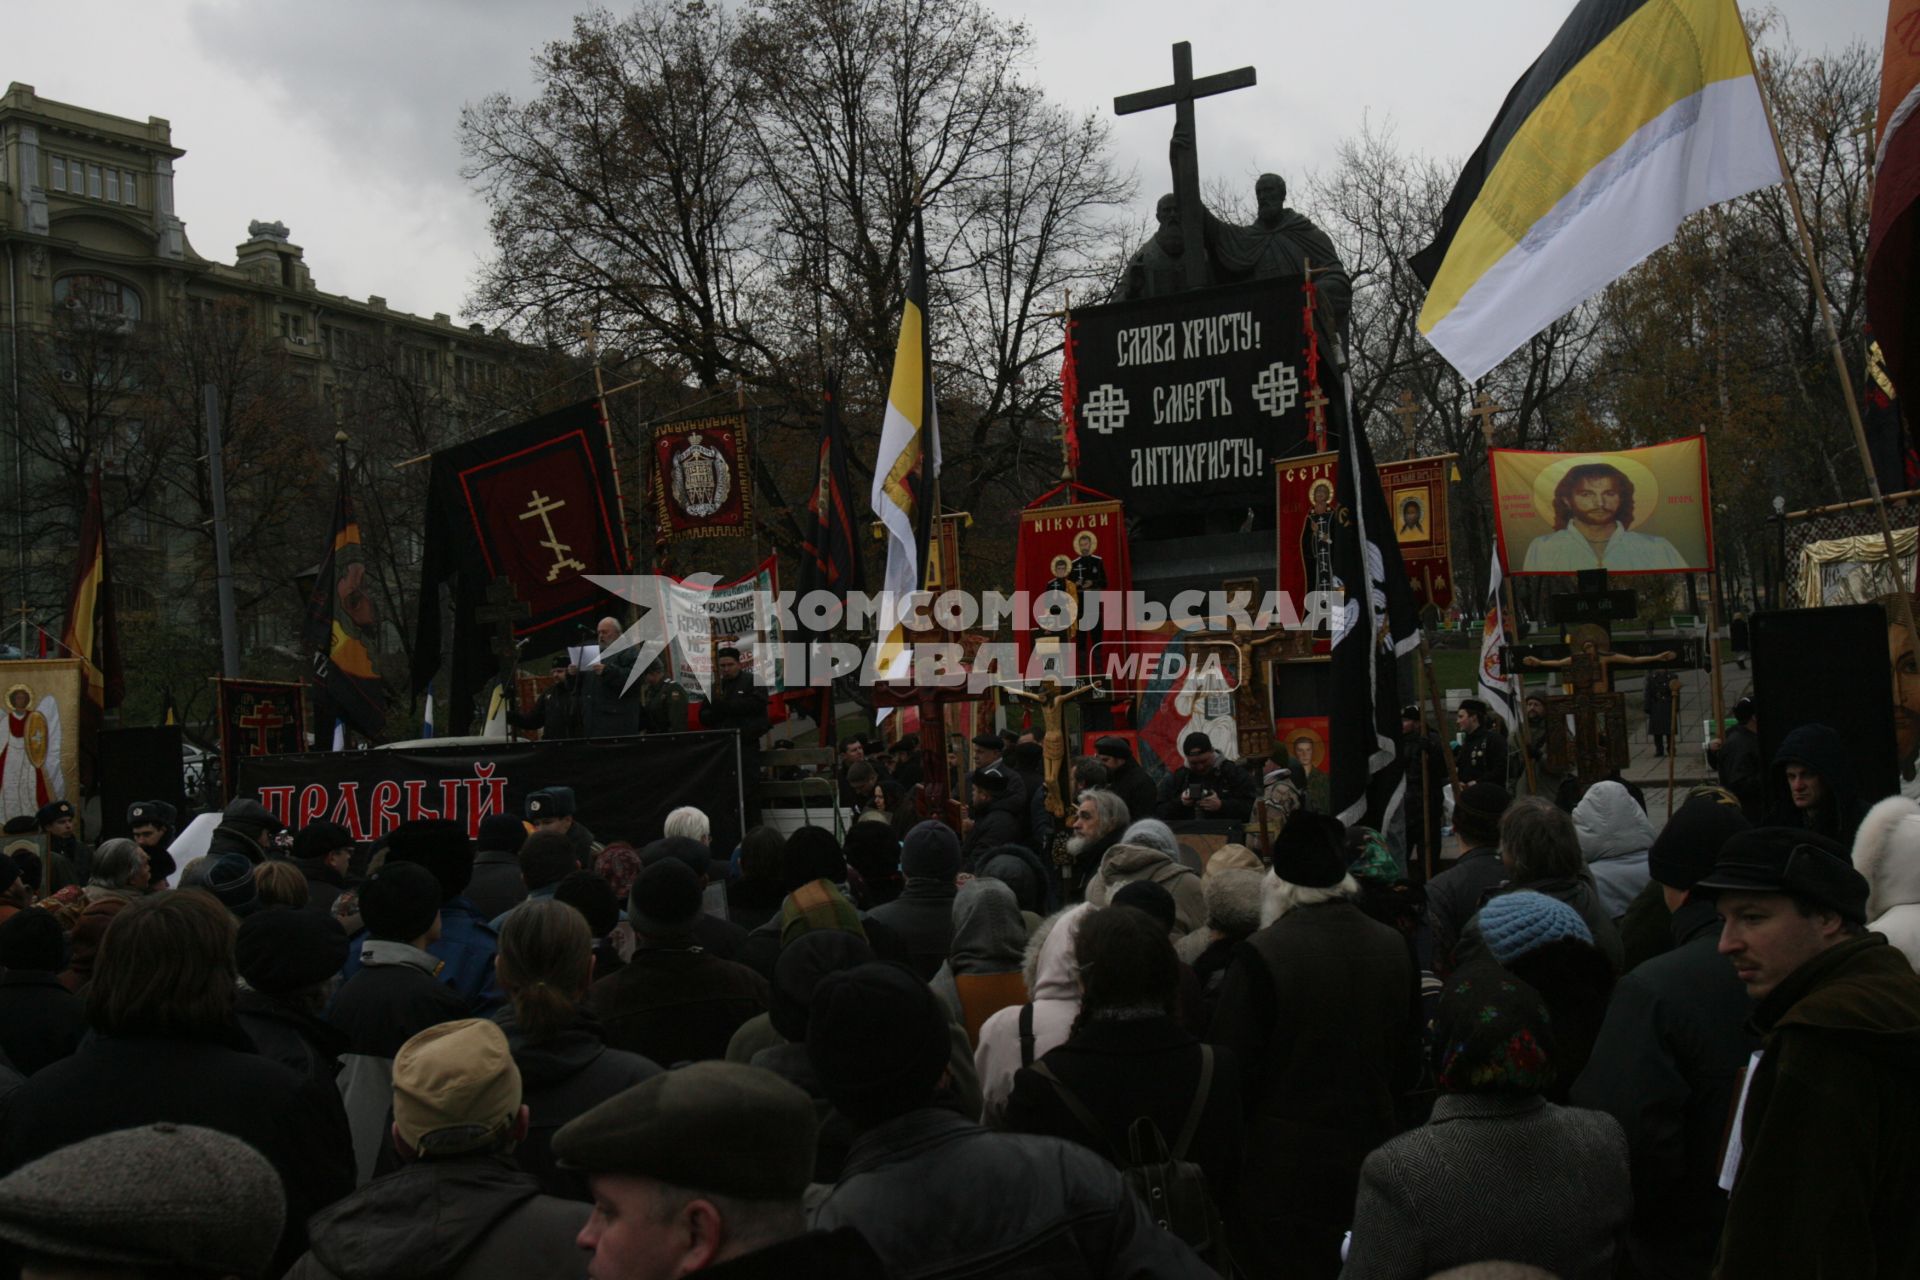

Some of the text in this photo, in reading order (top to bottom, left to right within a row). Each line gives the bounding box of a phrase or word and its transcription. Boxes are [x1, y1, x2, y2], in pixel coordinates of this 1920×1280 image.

[1117, 311, 1261, 368] СЛАВА ХРИСТУ!
[1152, 376, 1233, 425] СМЕРТЬ
[1130, 437, 1263, 488] АНТИХРИСТУ!
[257, 762, 508, 842] ПРАВЫЙ
